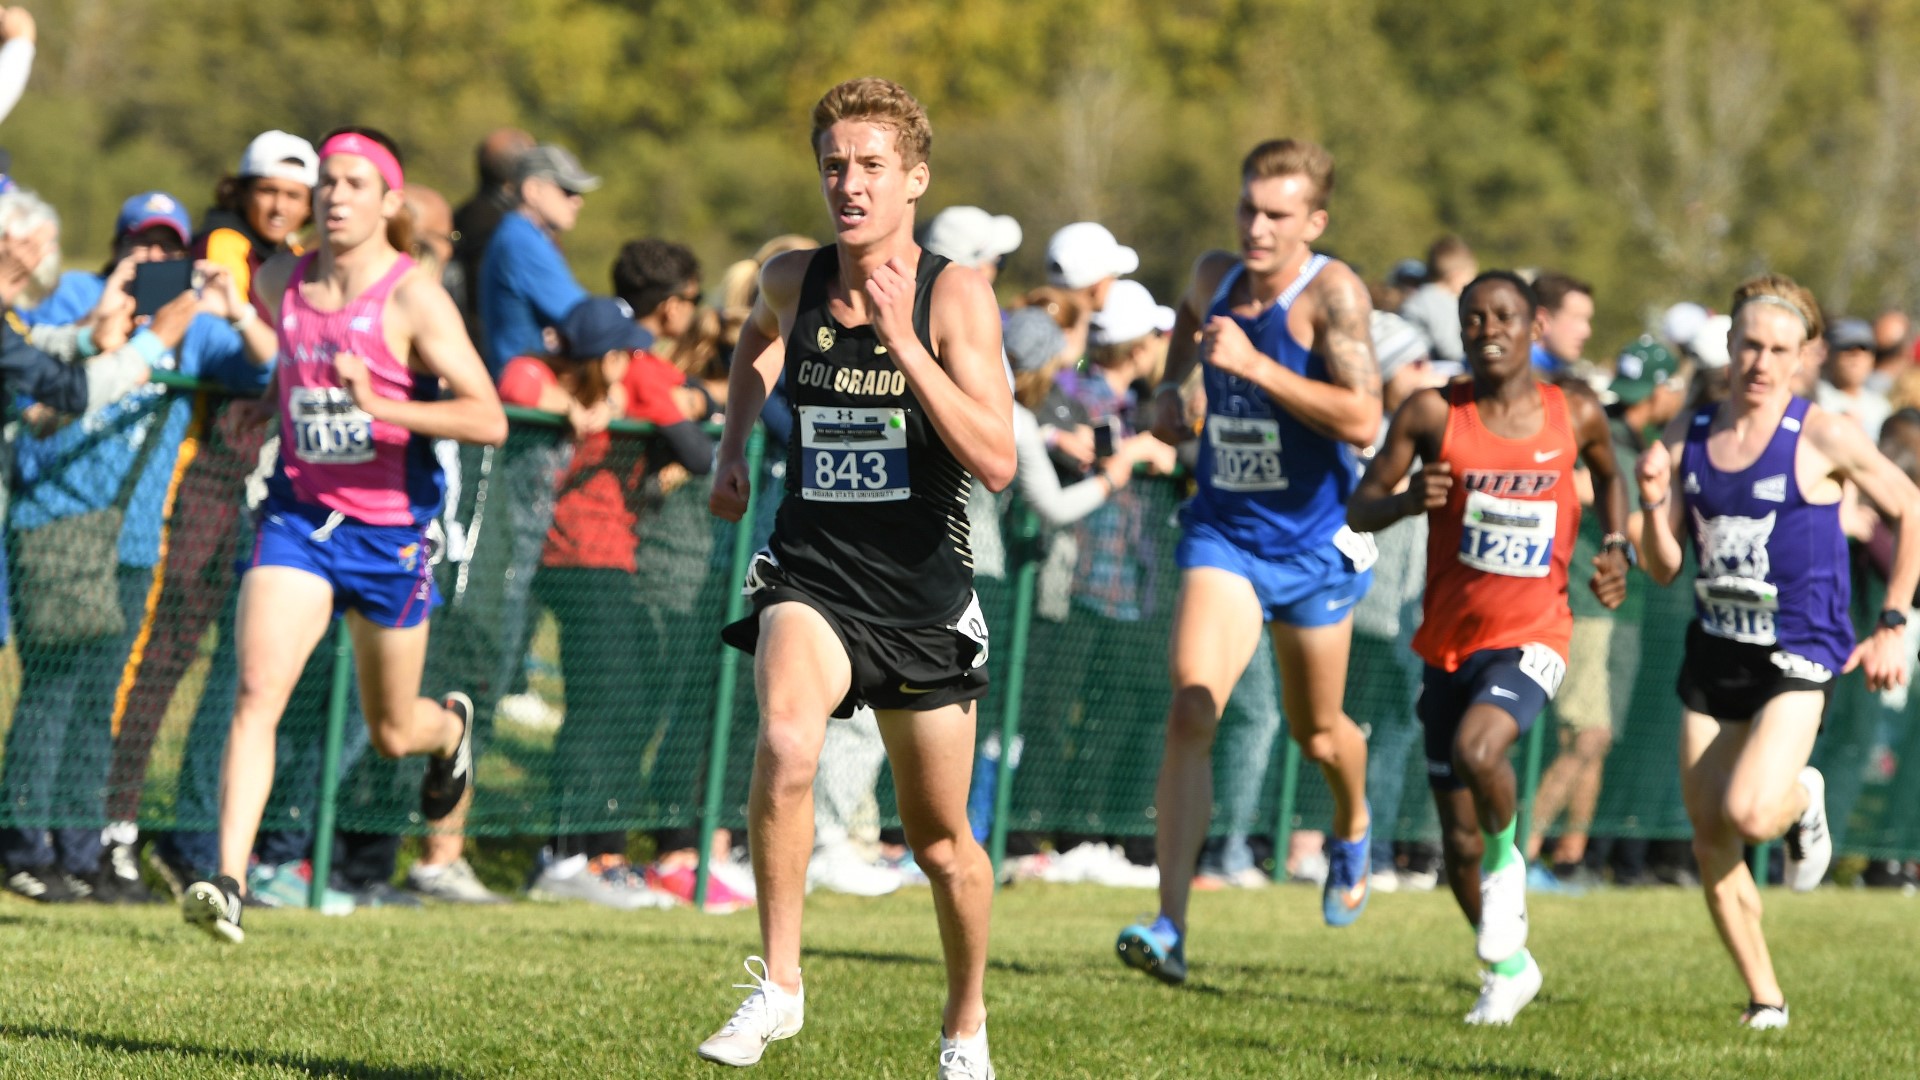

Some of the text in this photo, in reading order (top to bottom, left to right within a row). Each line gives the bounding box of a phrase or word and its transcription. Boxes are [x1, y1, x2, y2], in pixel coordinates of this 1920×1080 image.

[797, 360, 906, 396] COLORADO
[296, 419, 370, 453] 1003
[815, 450, 888, 490] 843
[1216, 449, 1282, 480] 1029
[1463, 469, 1560, 497] UTEP
[1469, 528, 1551, 568] 1267
